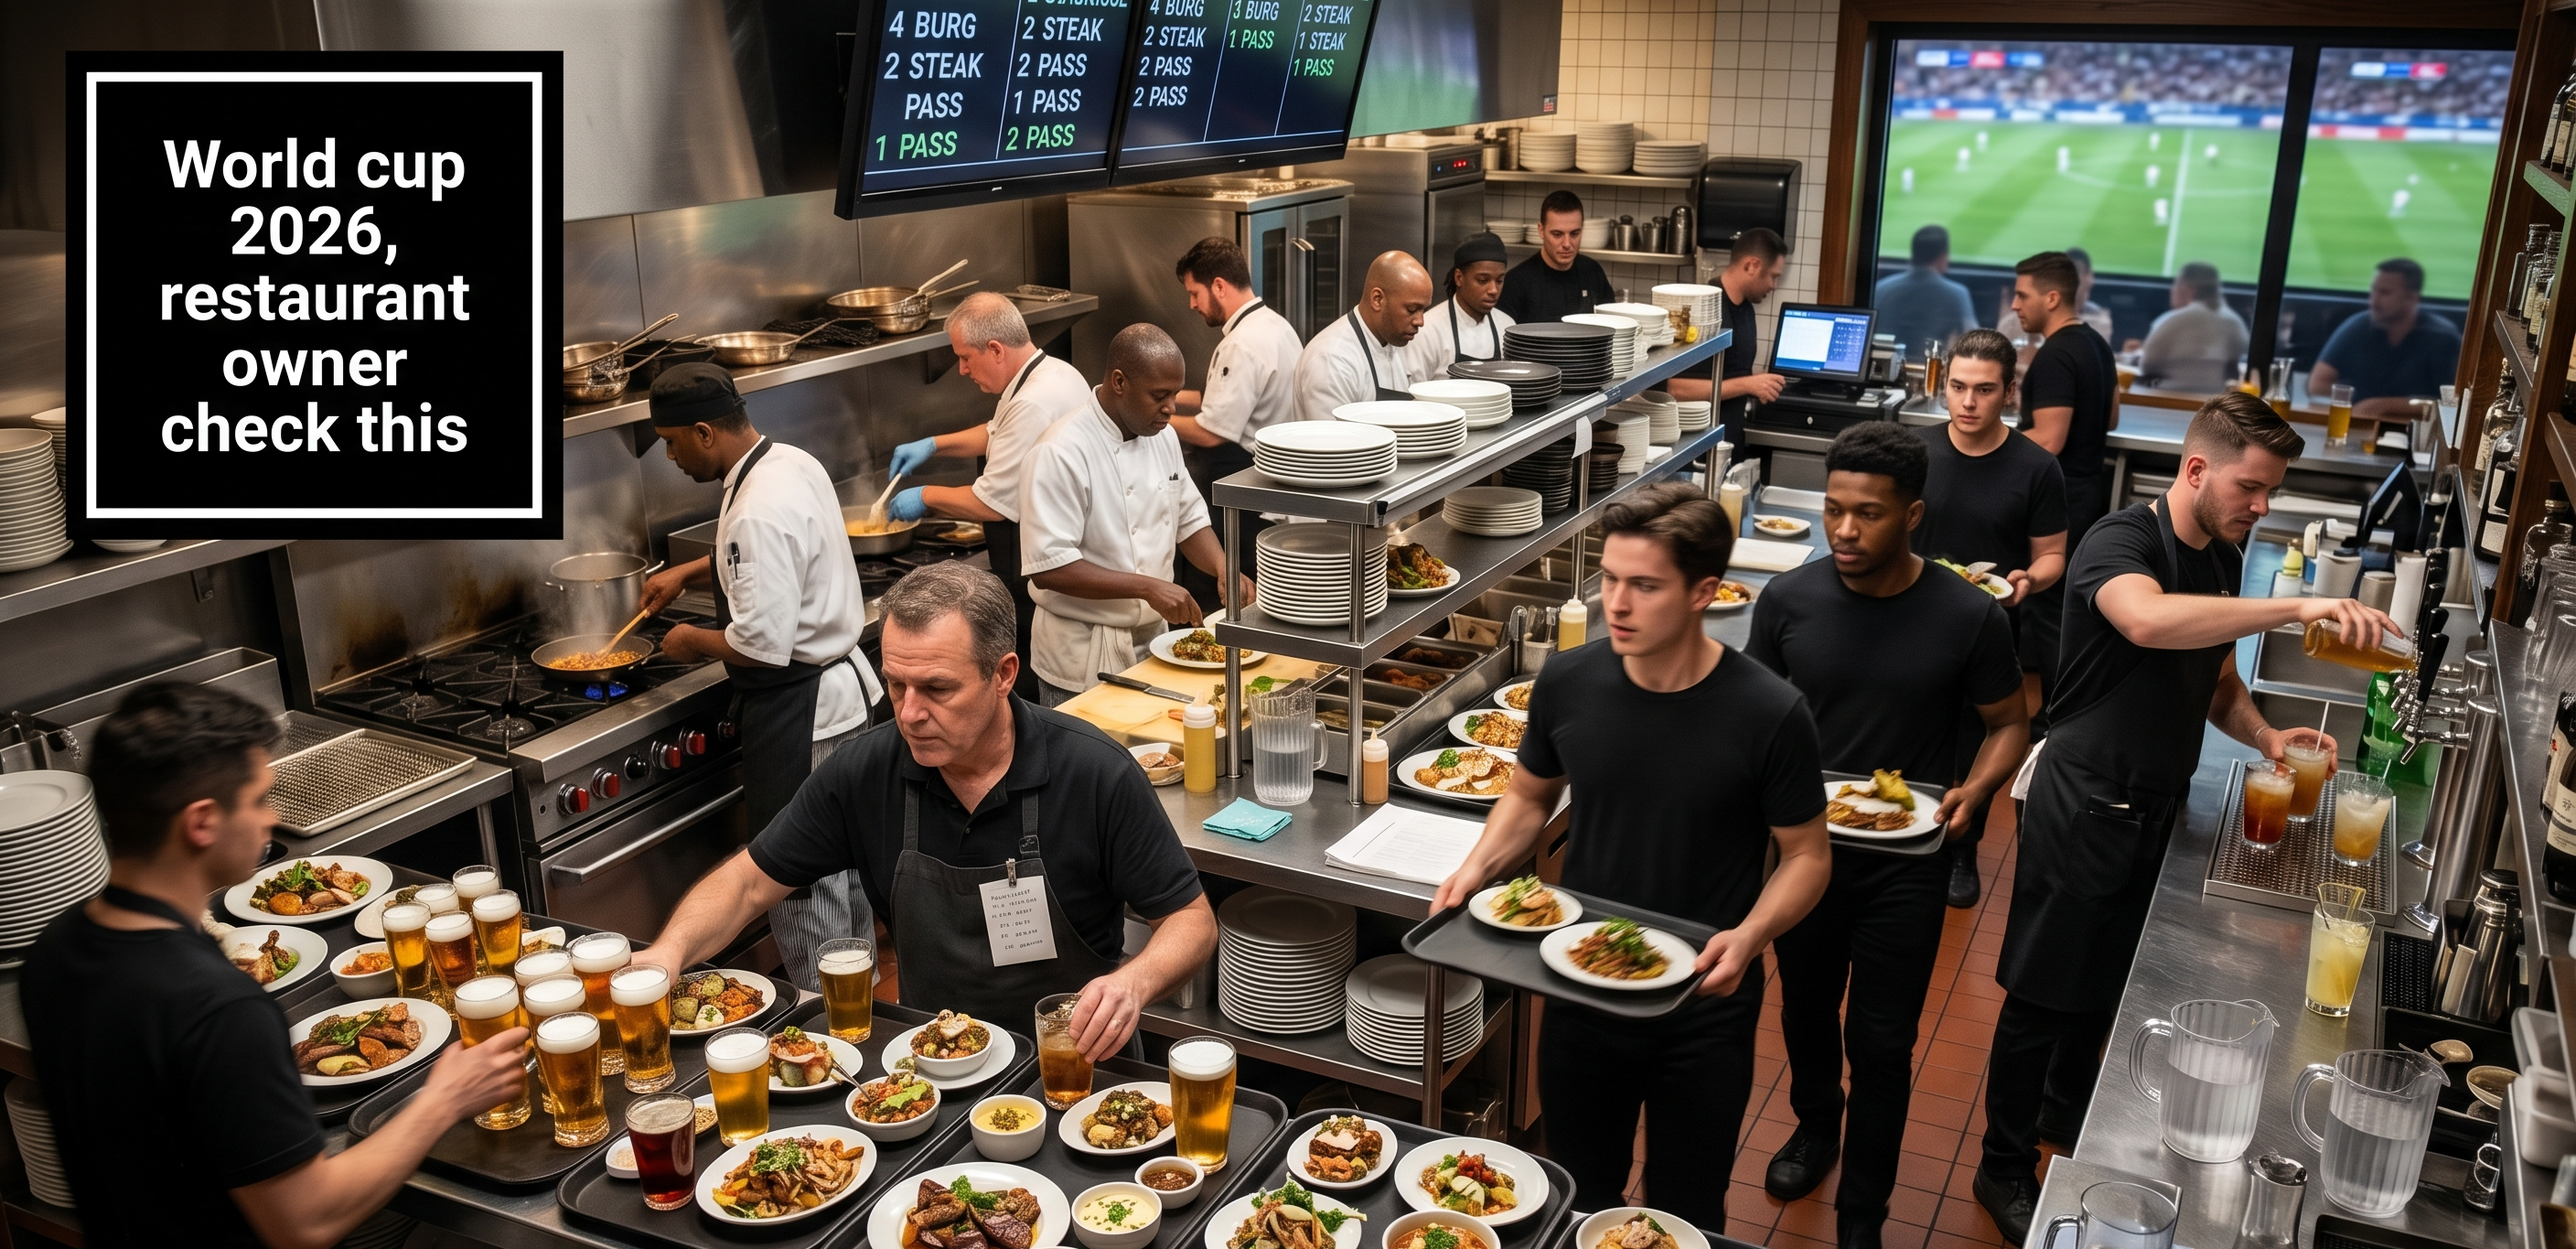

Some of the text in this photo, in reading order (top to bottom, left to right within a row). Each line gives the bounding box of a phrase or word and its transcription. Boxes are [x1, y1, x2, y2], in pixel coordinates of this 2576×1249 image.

[1149, 0, 1204, 16] 4 BURG
[1233, 0, 1279, 20] 3 BURG
[1304, 5, 1353, 25] 2 STEAK
[889, 11, 976, 38] 4 BURG
[1023, 16, 1104, 41] 2 STEAK
[1143, 26, 1207, 47] 2 STEAK
[1229, 29, 1274, 48] 1 PASS
[1299, 32, 1347, 50] 1 STEAK
[884, 52, 983, 79] 2 STEAK
[1017, 53, 1087, 77] 2 PASS
[1139, 57, 1192, 76] 2 PASS
[1293, 59, 1334, 76] 1 PASS
[905, 92, 963, 120] PASS
[1014, 89, 1081, 114] 1 PASS
[1133, 86, 1187, 106] 2 PASS
[875, 131, 957, 161] 1 PASS
[1005, 124, 1075, 151] 2 PASS
